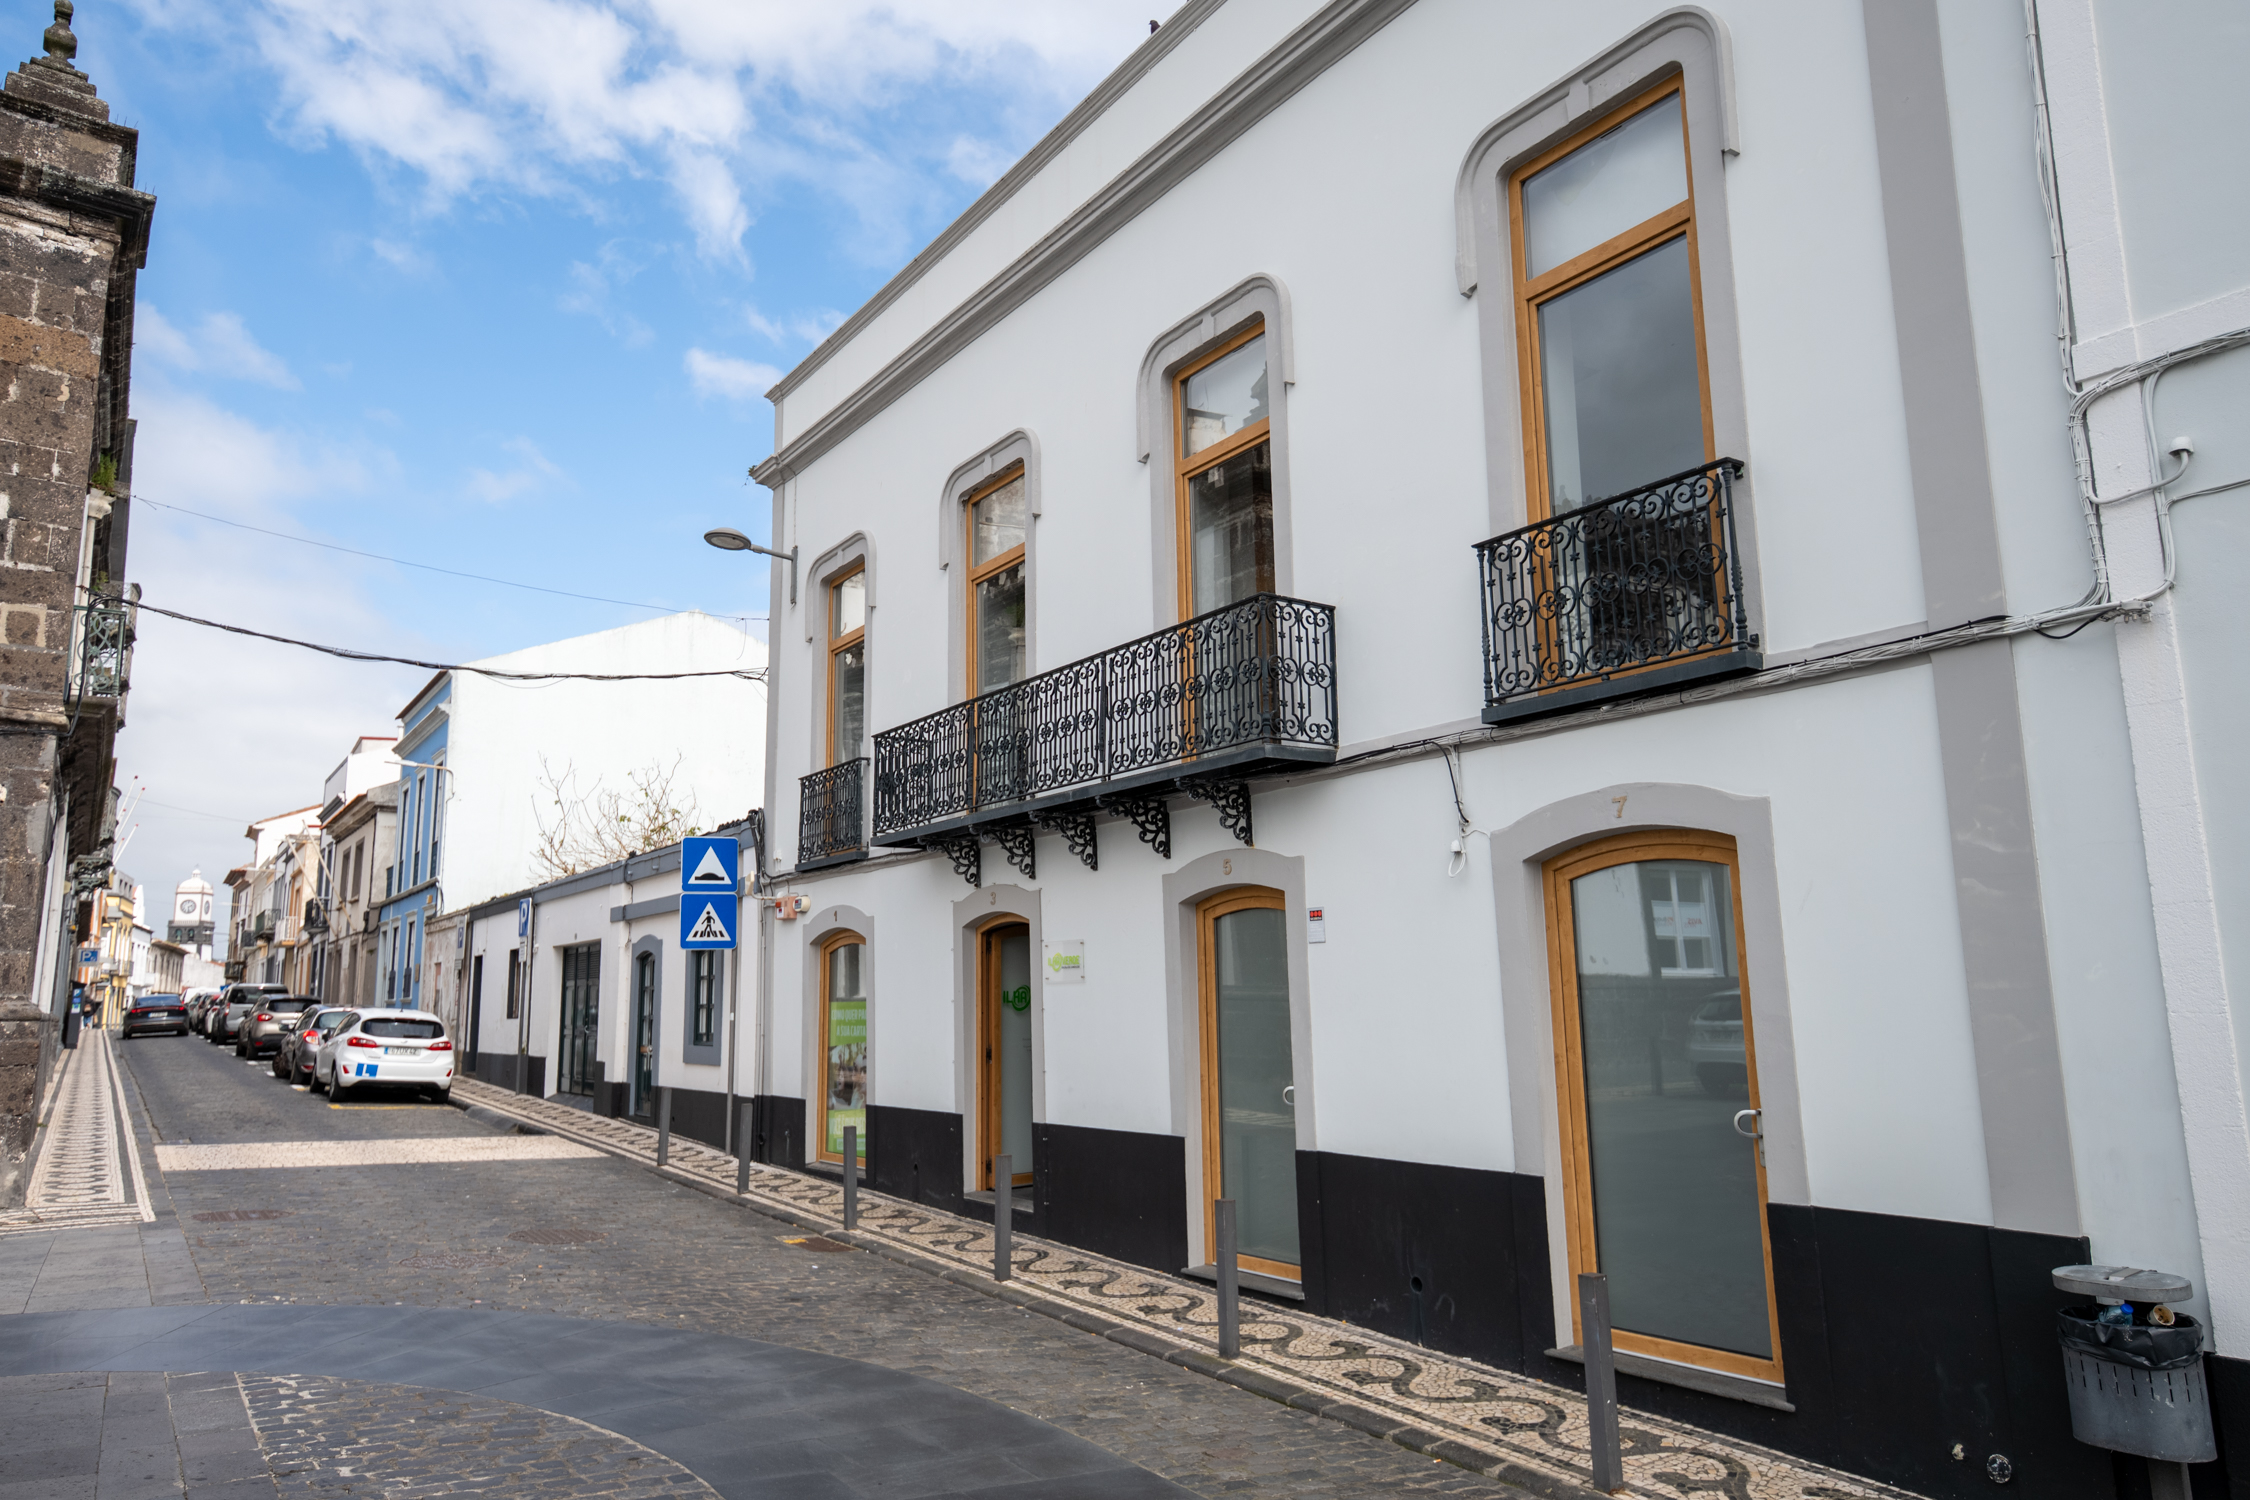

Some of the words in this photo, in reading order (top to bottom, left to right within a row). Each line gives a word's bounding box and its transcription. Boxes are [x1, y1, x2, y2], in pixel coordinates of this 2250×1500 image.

[1611, 795, 1627, 818] 7
[1223, 858, 1232, 876] 5
[990, 891, 996, 905] 3
[520, 902, 528, 934] P
[834, 910, 838, 921] 1
[82, 951, 92, 962] P
[1003, 988, 1030, 1007] ILHA
[362, 1064, 370, 1077] L
